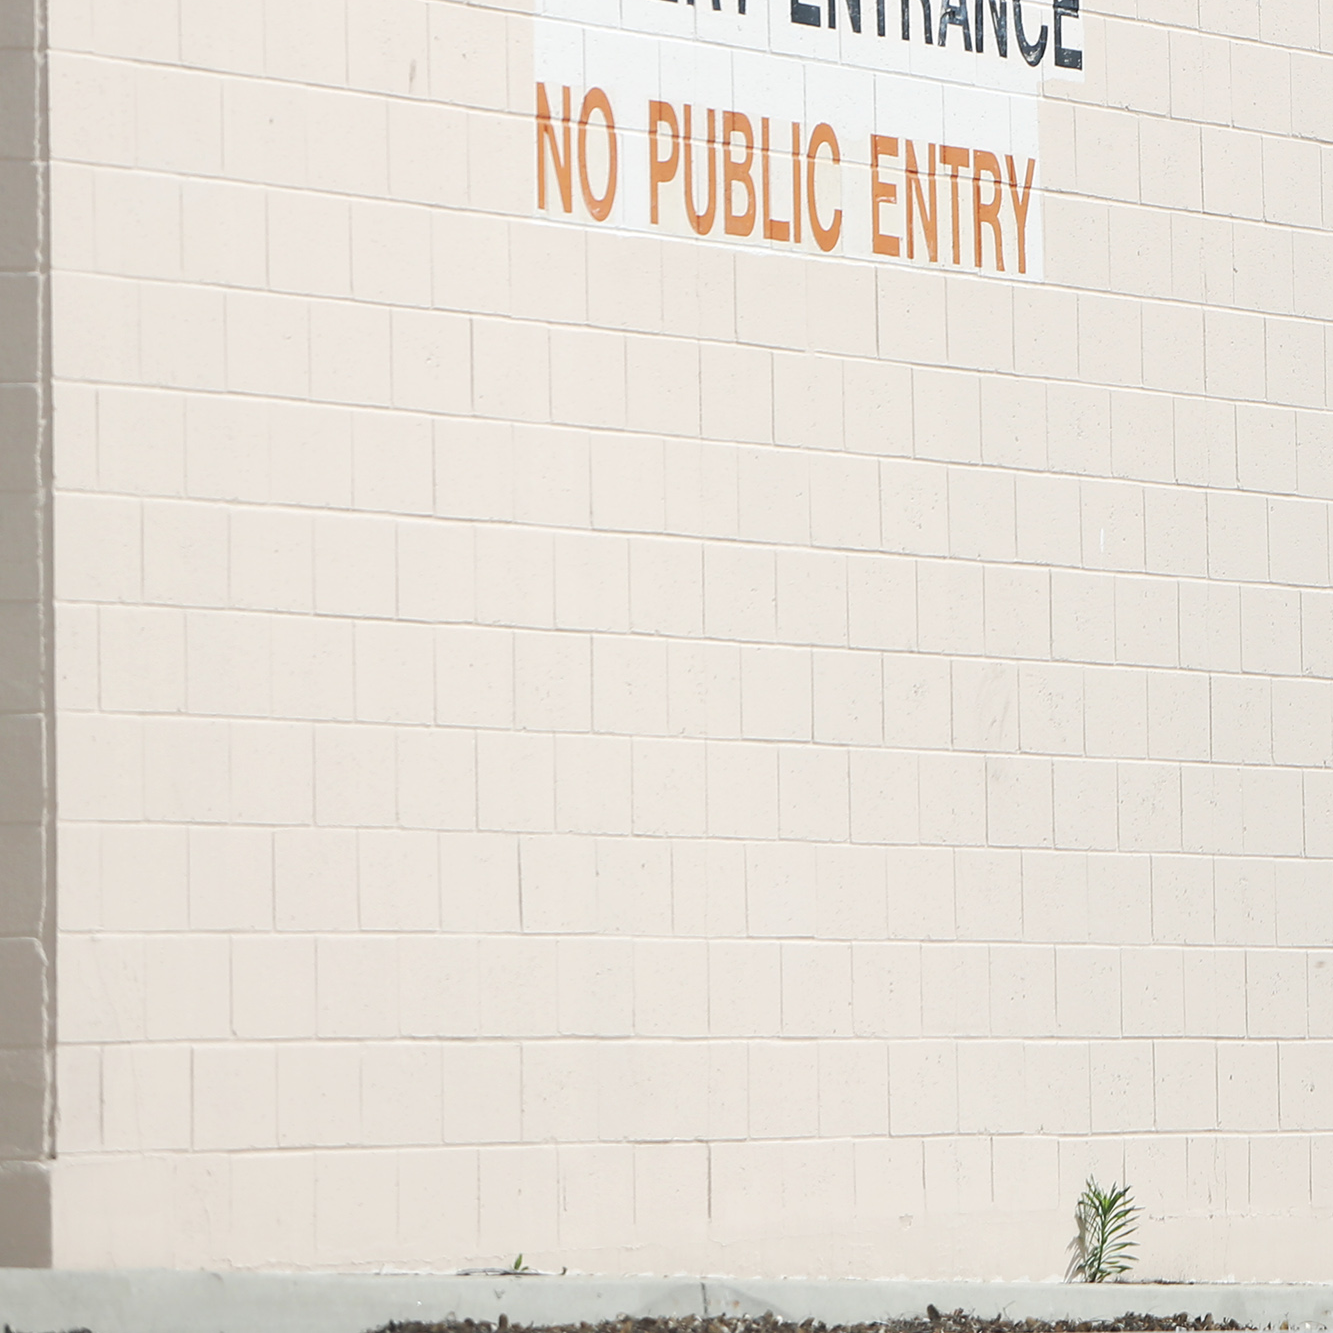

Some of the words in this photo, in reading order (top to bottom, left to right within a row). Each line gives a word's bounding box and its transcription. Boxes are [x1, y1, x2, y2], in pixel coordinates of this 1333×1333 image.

[536, 83, 617, 222] NO
[649, 101, 842, 252] PUBLIC
[871, 135, 1034, 274] ENTRY
